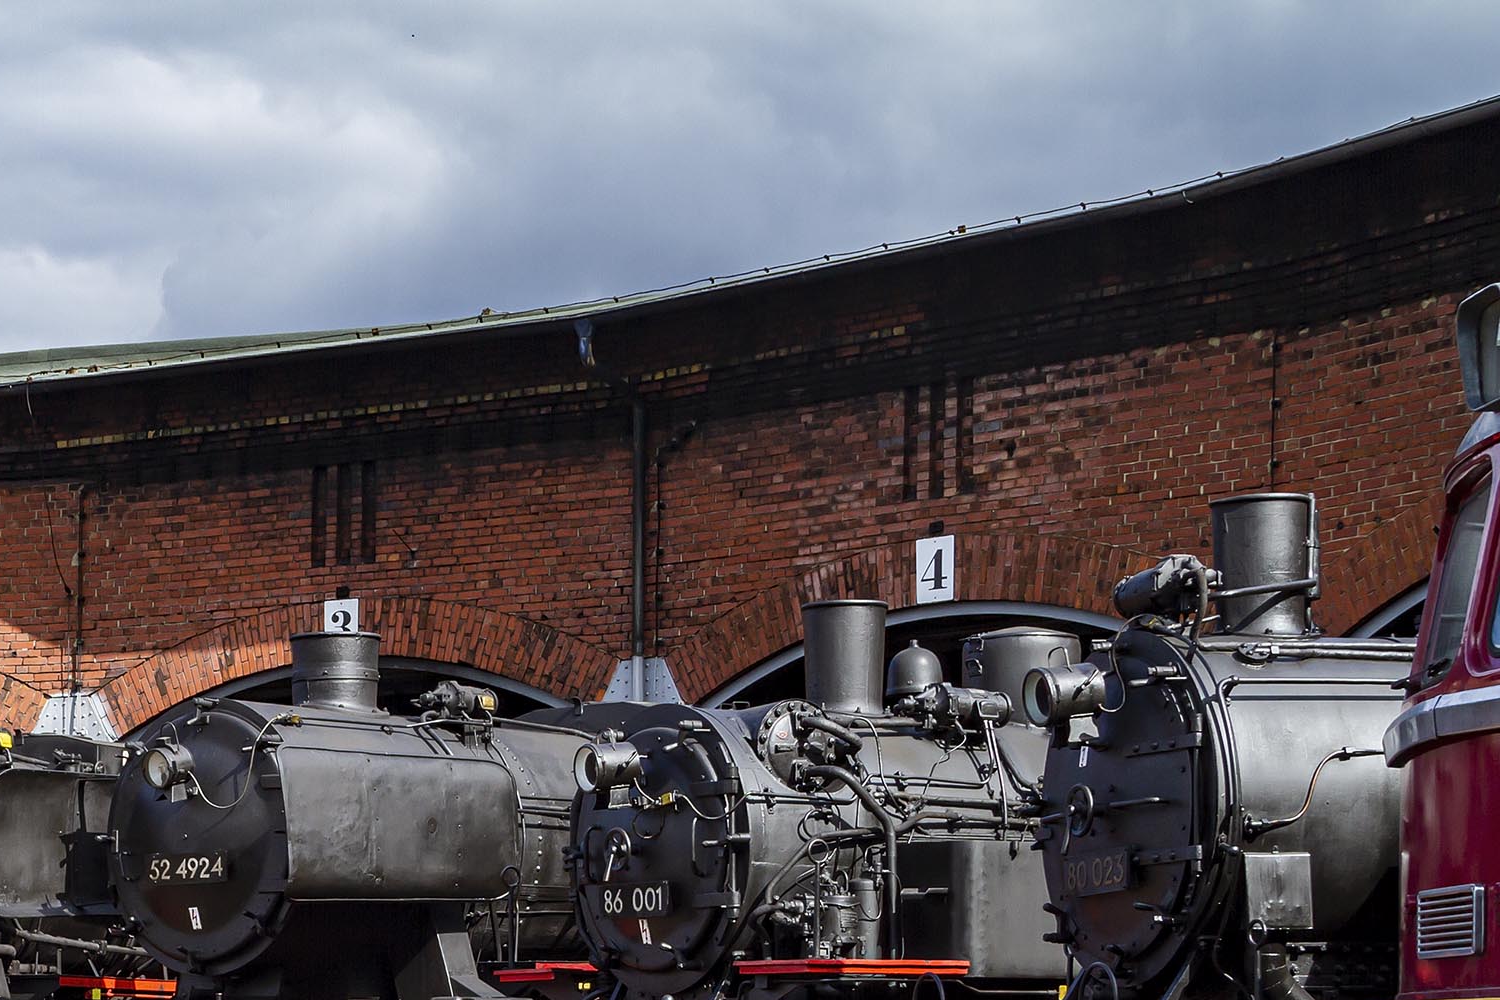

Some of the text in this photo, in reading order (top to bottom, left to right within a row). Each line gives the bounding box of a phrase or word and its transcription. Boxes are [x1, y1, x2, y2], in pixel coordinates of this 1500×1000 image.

[920, 548, 948, 591] 4
[331, 610, 352, 632] 3
[149, 856, 224, 880] 52 4924
[1067, 854, 1124, 890] 80 023
[604, 886, 663, 913] 86 001
